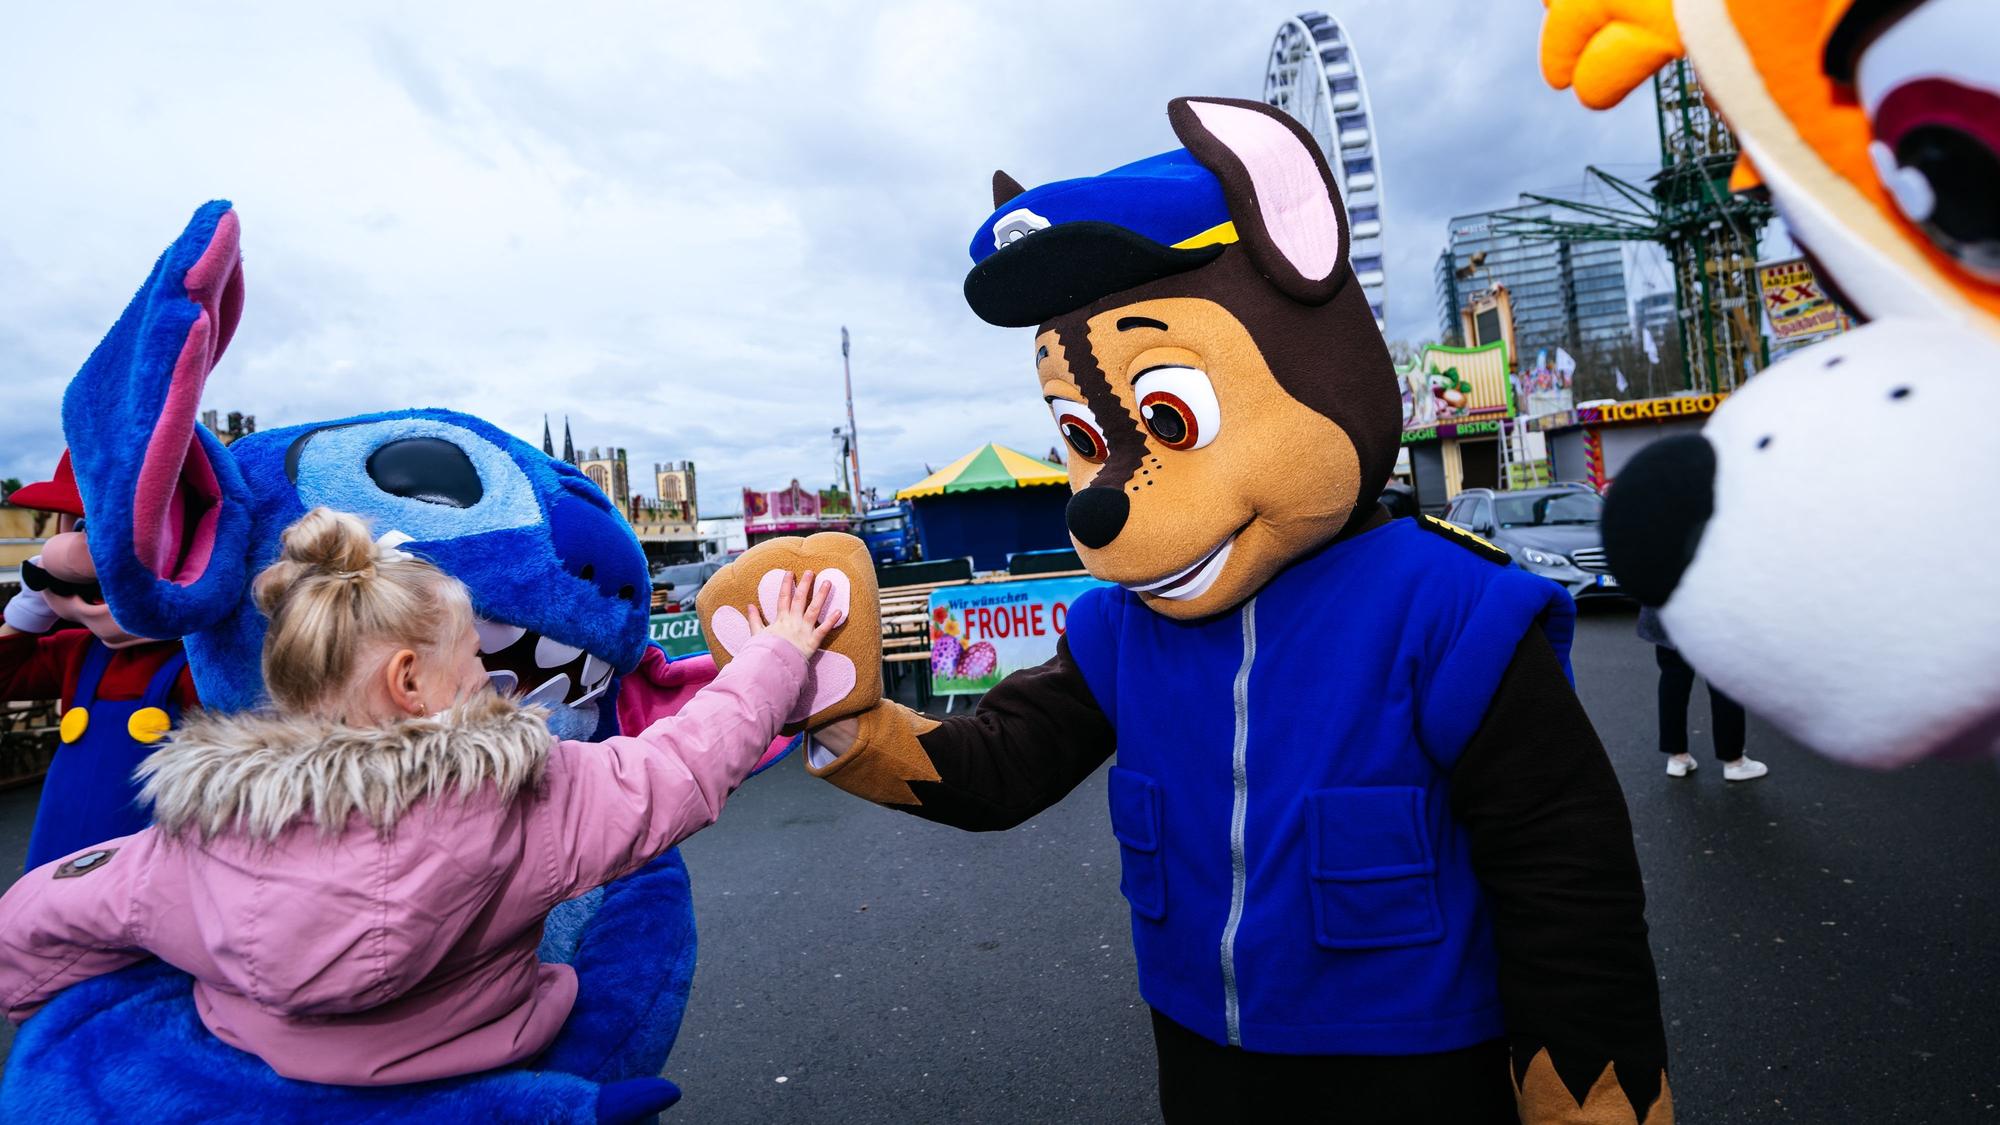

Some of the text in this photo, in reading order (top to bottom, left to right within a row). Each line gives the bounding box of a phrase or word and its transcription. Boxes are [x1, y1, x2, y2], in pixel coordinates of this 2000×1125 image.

[1457, 420, 1500, 435] BISTRO
[948, 592, 1029, 610] Wir wünschen
[650, 619, 700, 640] LICH
[964, 604, 1046, 640] FROHE
